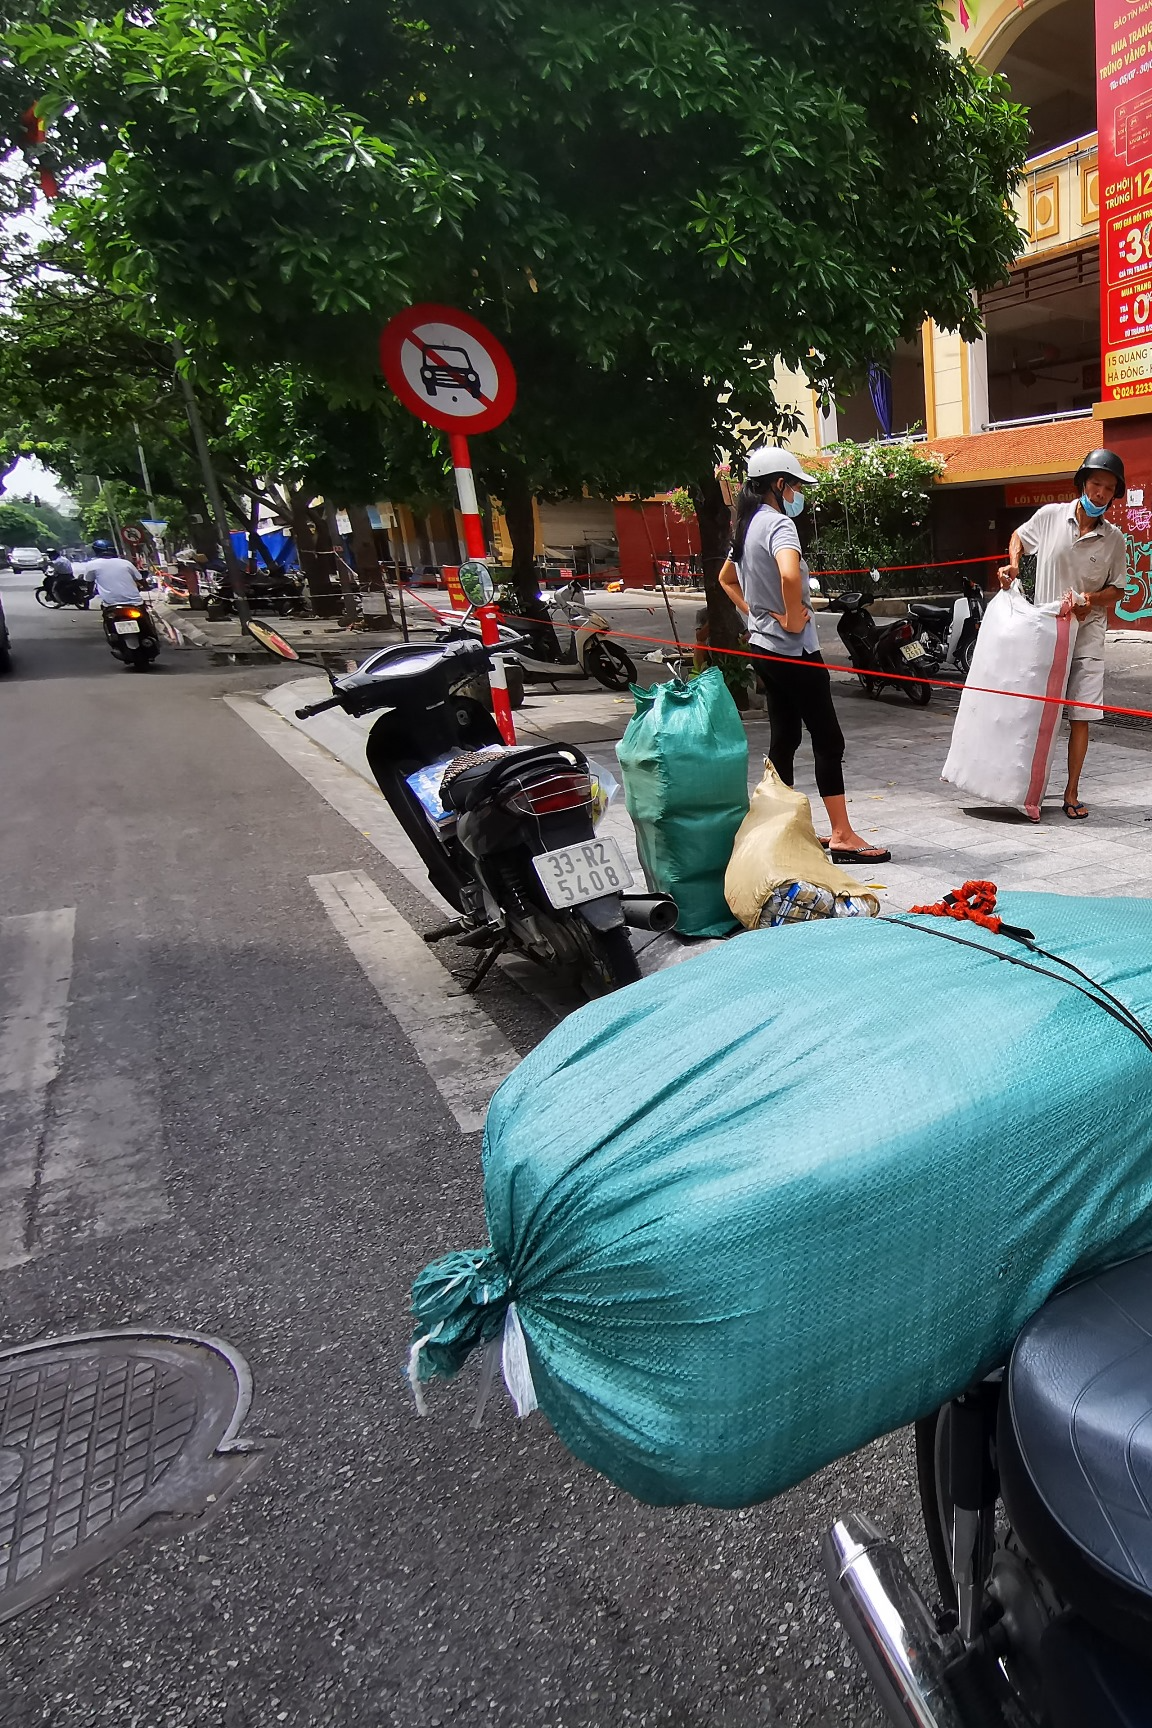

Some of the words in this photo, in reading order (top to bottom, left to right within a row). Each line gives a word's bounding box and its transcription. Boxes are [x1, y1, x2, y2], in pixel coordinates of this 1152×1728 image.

[1111, 37, 1127, 55] MUA
[1100, 58, 1122, 80] TRÚNG
[1124, 45, 1146, 65] VÀNG
[1119, 68, 1136, 85] 05/07
[1105, 183, 1115, 196] CƠ
[1117, 177, 1130, 192] HỘI
[1105, 192, 1130, 210] TRÚNG
[1113, 220, 1122, 231] TRỢ
[1124, 216, 1132, 227] GIÁ
[1134, 263, 1148, 273] TRANG
[1121, 288, 1133, 297] MUA
[1134, 281, 1151, 293] TRANG
[1108, 356, 1116, 367] 15
[1119, 349, 1148, 364] QUANG
[1108, 369, 1119, 383] HÀ
[1120, 365, 1144, 380] ĐÔNG
[1121, 386, 1134, 397] 024
[1136, 382, 1152, 394] 2233
[547, 843, 610, 878] 33-R2
[558, 866, 620, 901] 5408
